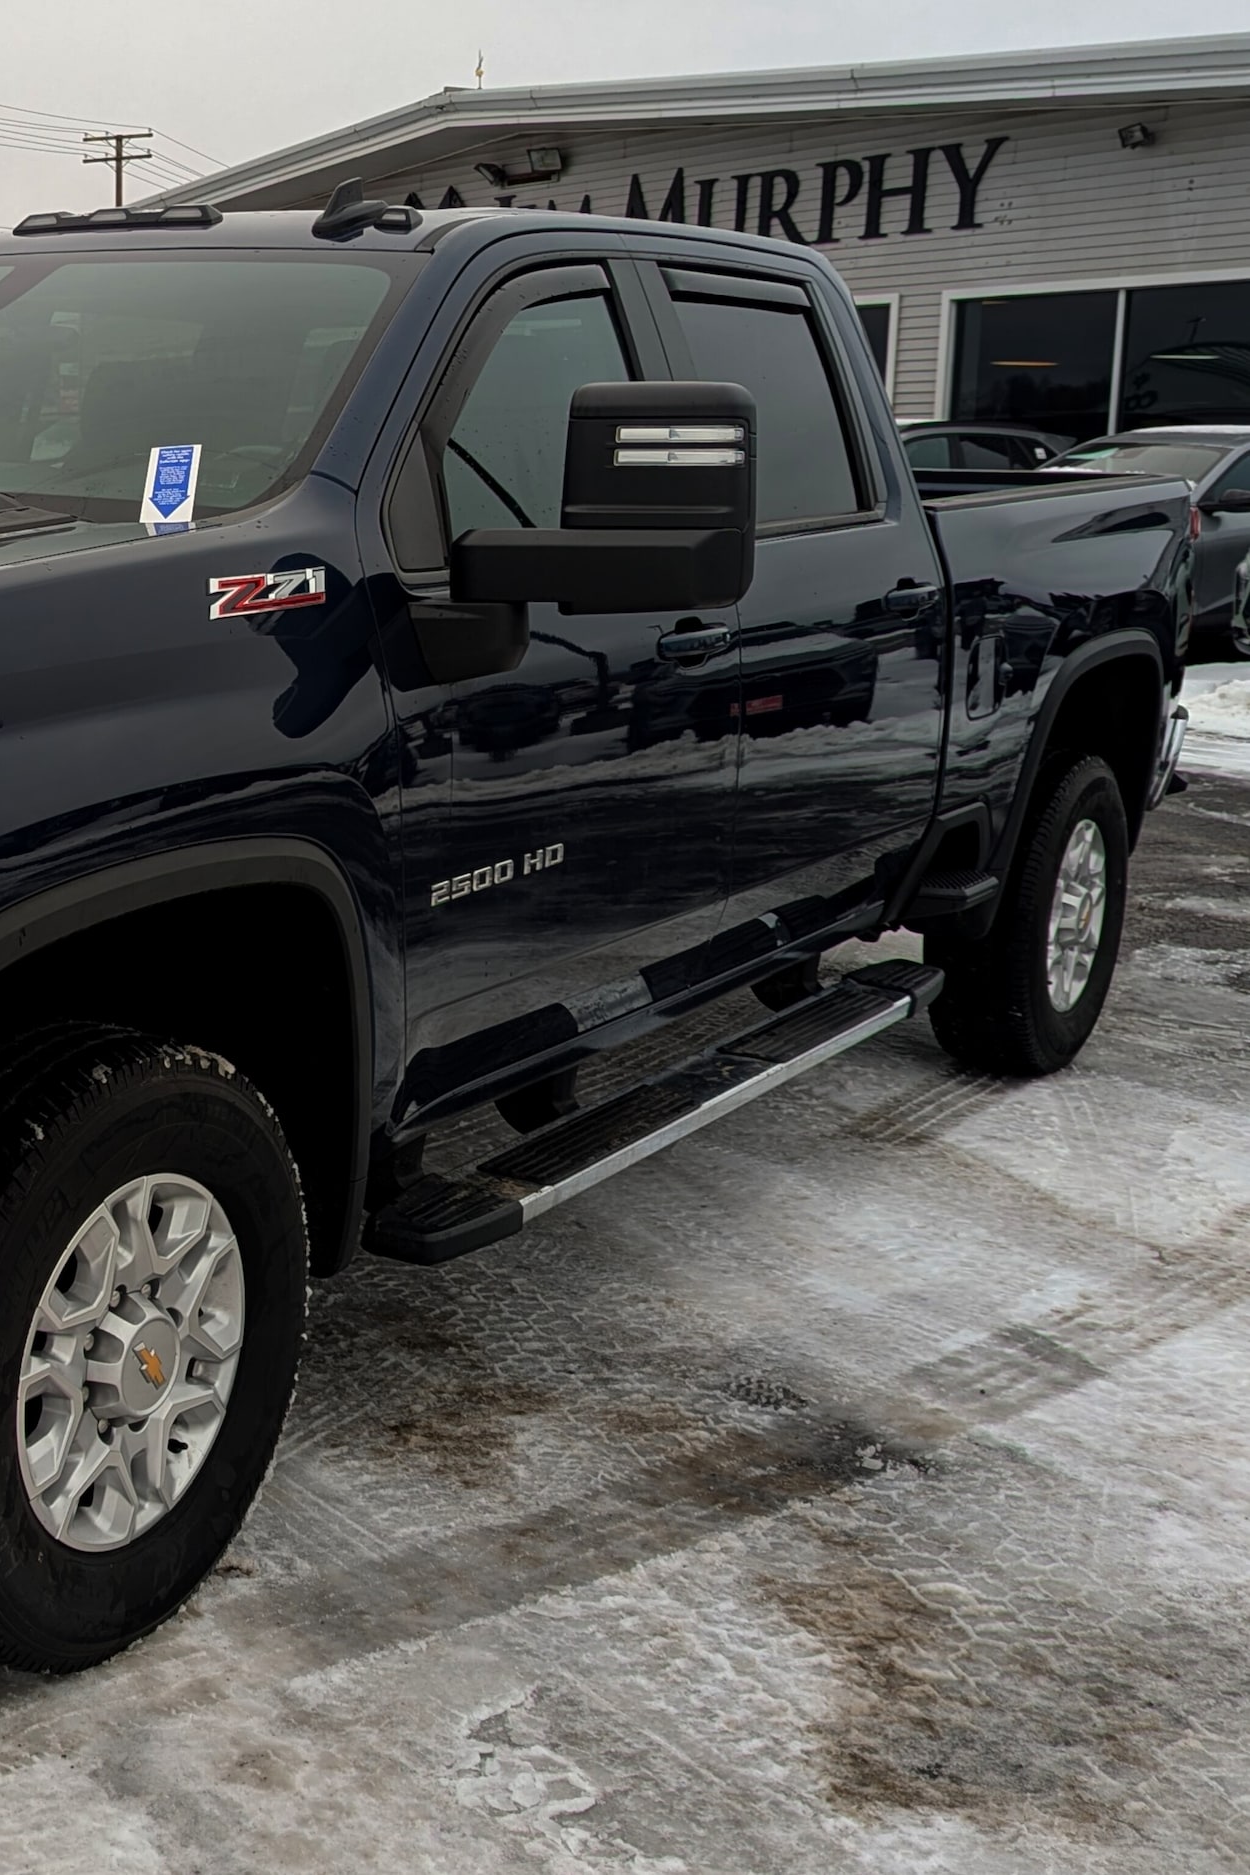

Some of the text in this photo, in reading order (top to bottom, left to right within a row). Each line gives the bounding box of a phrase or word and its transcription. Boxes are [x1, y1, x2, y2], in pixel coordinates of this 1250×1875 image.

[624, 136, 1010, 246] MURPHY
[208, 566, 327, 620] Z71
[430, 843, 565, 907] 2500 HD
